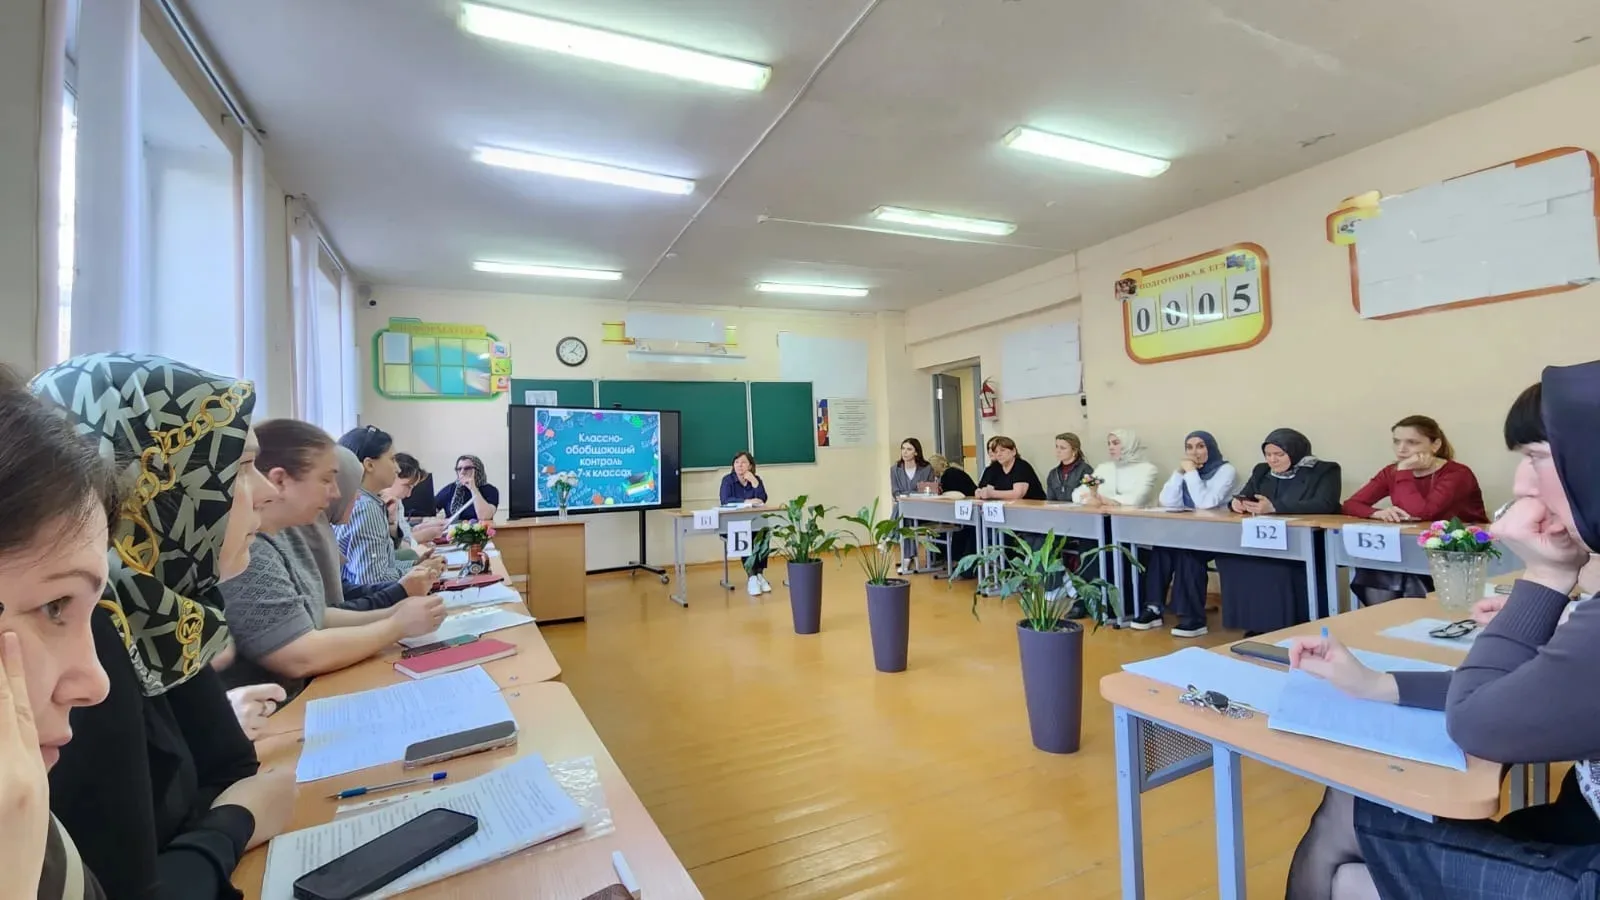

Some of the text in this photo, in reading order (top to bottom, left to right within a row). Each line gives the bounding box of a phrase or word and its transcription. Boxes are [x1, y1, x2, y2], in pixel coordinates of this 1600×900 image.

[1139, 270, 1196, 289] ПОДГОТОВКА
[578, 432, 624, 443] Классно-
[565, 445, 635, 455] обобщающий
[579, 457, 622, 467] контроль
[592, 469, 632, 478] классах
[988, 506, 998, 516] Б5
[1255, 525, 1278, 540] Б2
[734, 531, 748, 551] Б
[1356, 532, 1386, 549] Б3
